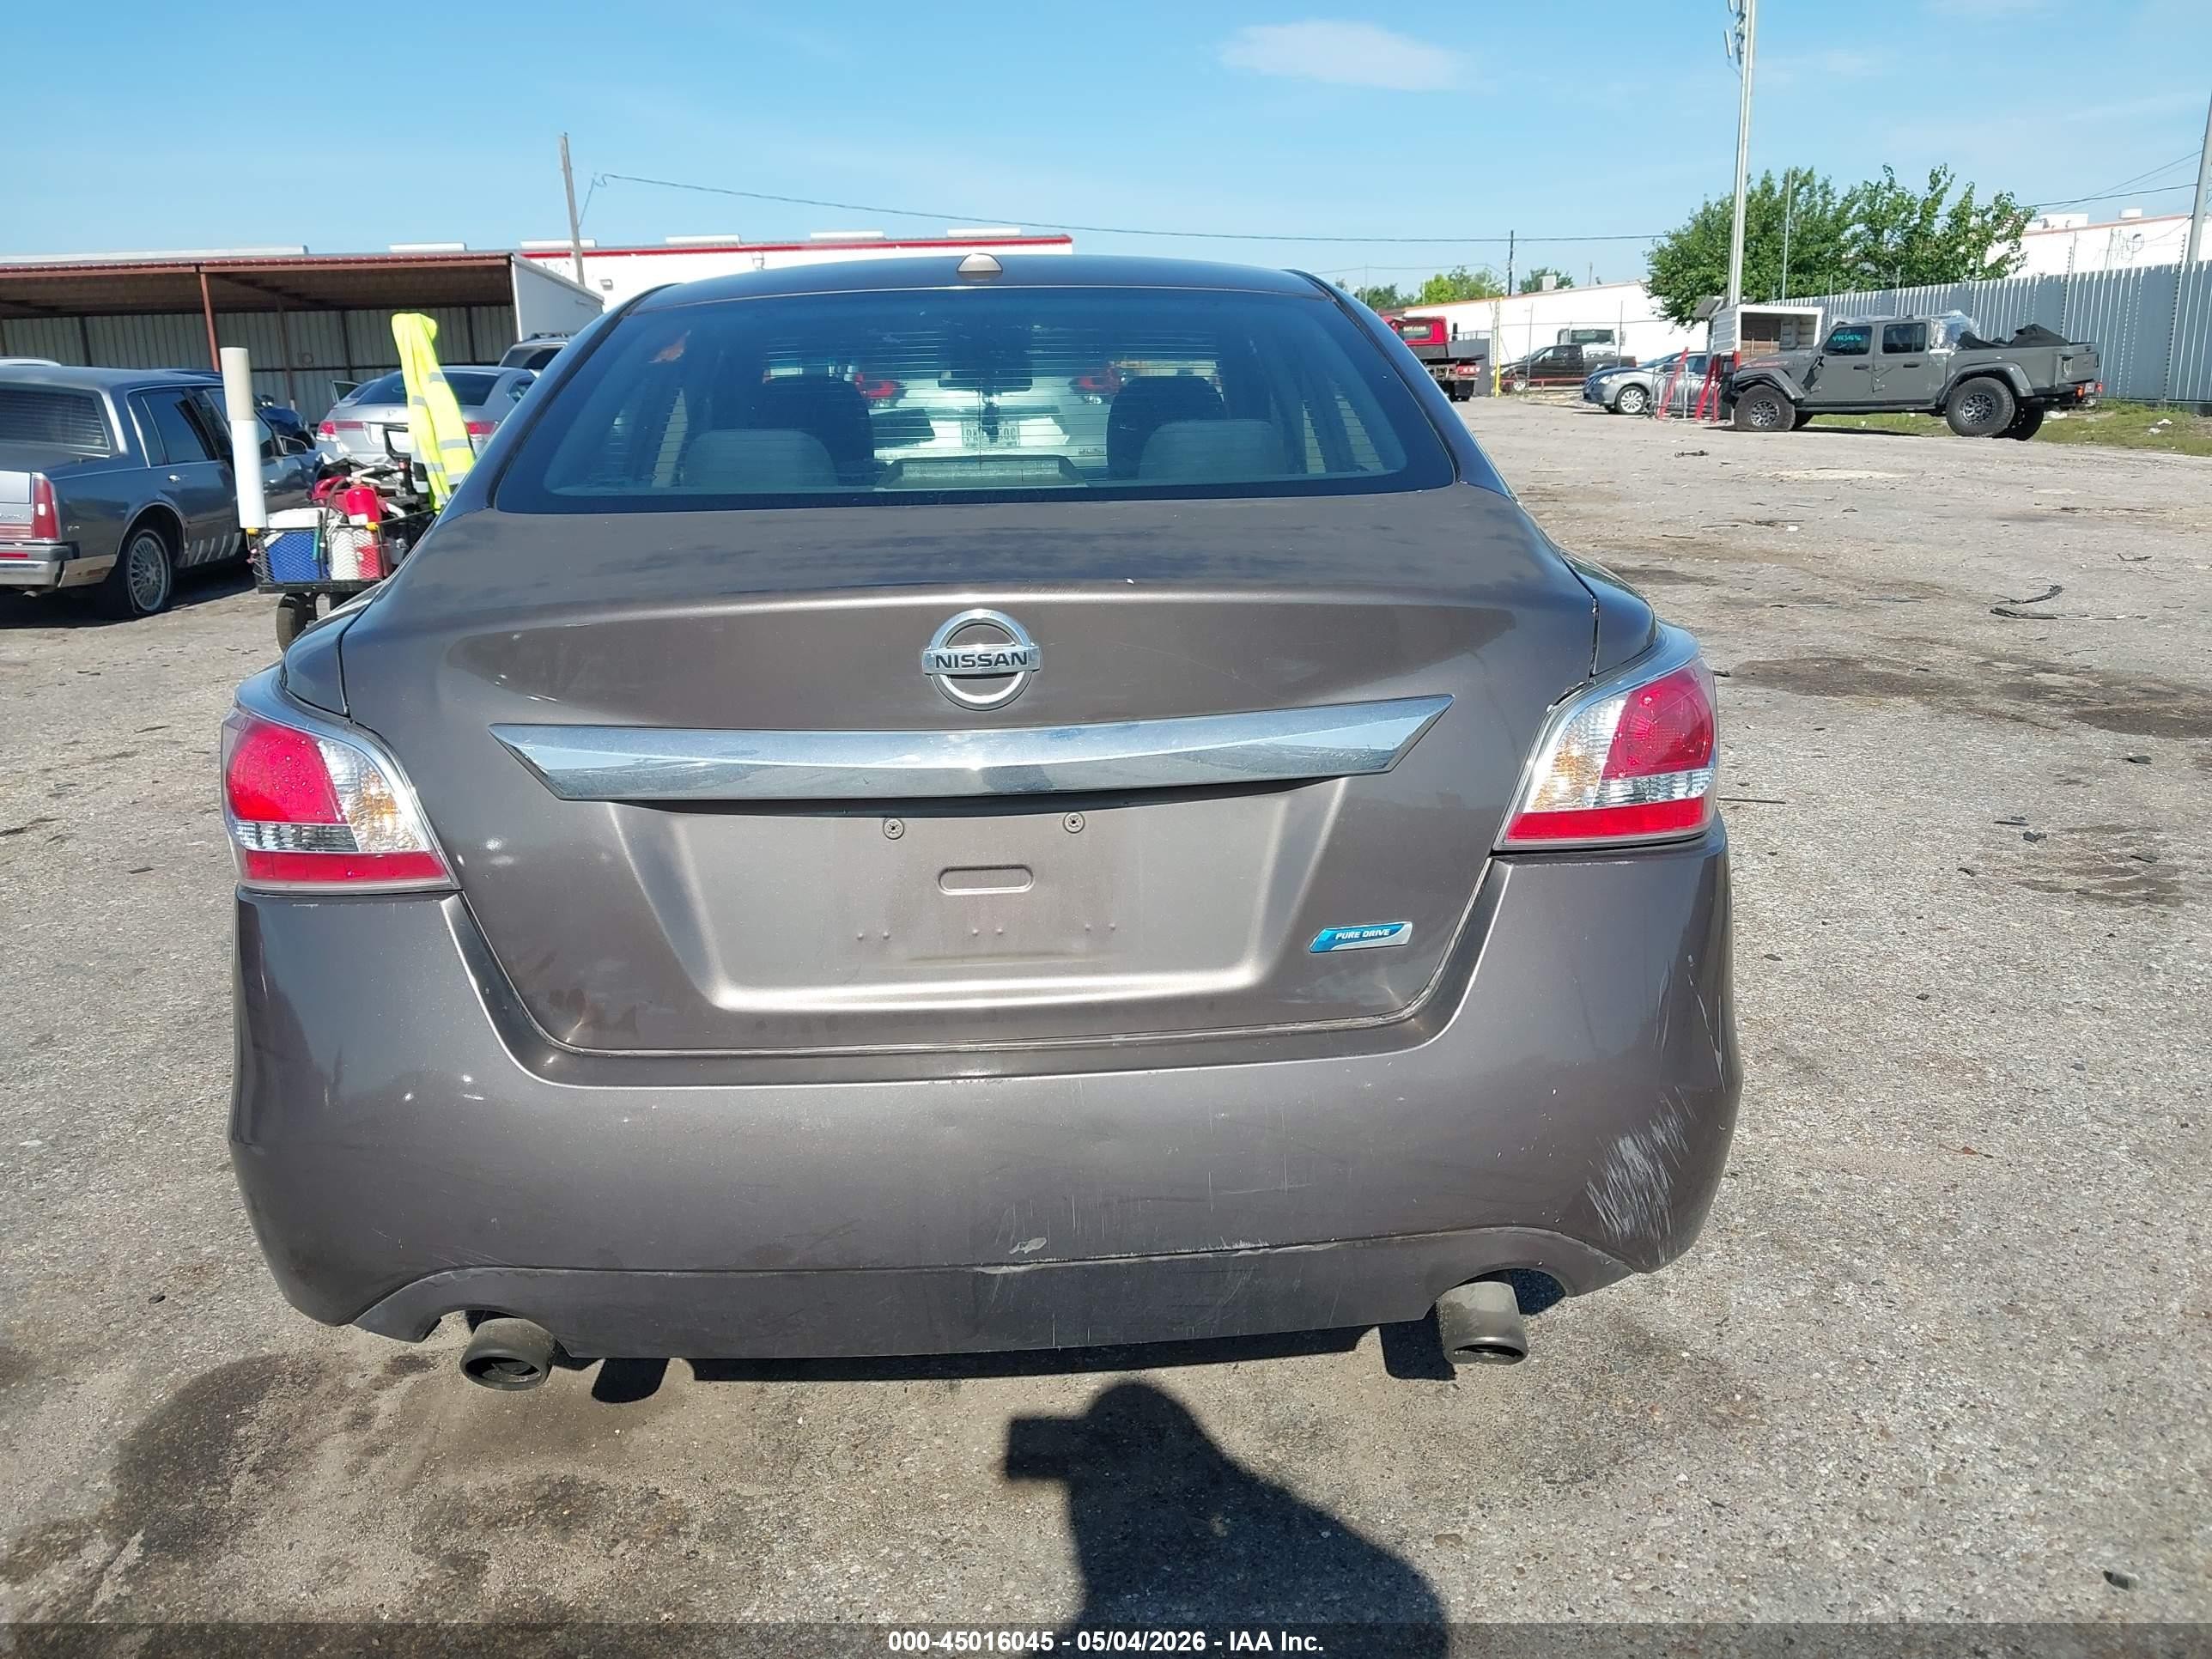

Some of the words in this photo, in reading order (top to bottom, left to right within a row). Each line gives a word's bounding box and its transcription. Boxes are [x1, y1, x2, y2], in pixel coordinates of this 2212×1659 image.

[935, 651, 1028, 669] NISSAN
[1335, 931, 1360, 940] PURE
[1362, 928, 1390, 938] DRIVE
